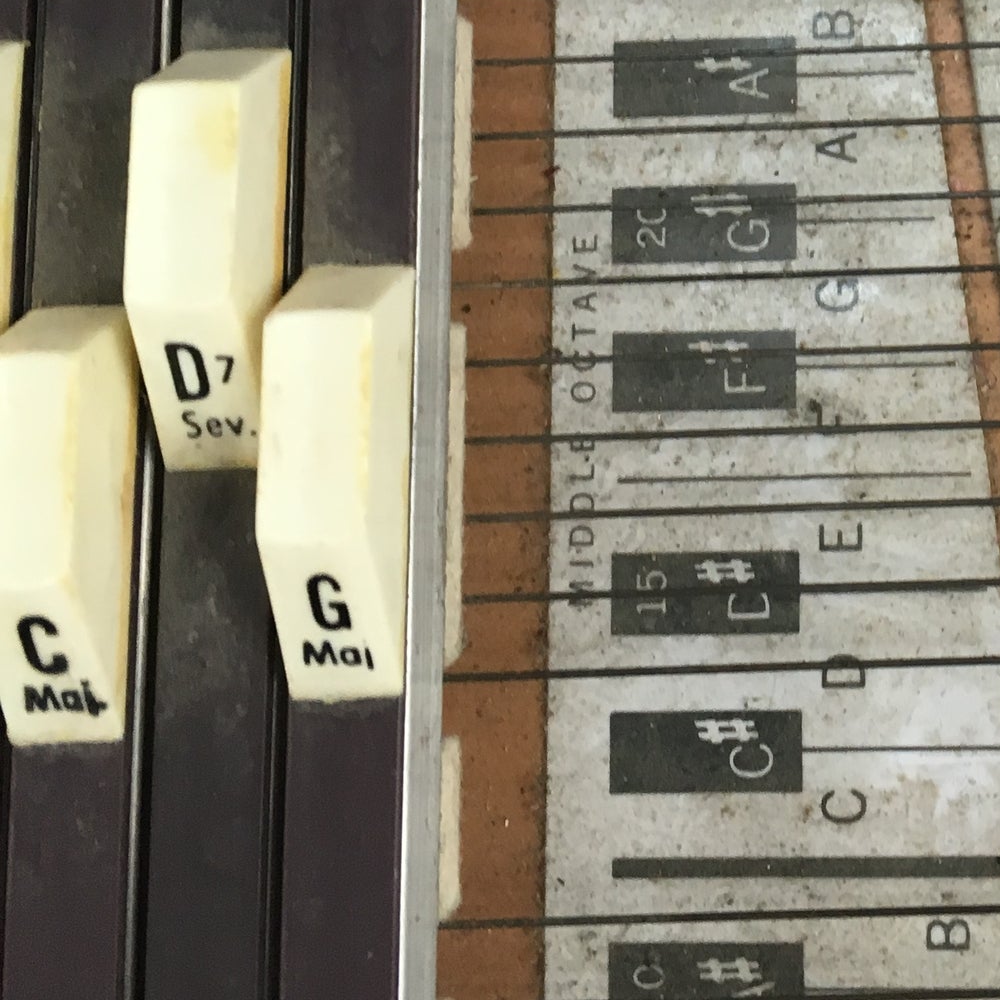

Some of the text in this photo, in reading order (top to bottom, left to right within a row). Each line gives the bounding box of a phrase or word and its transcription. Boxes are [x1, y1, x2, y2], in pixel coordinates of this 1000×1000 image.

[813, 9, 855, 40] B
[816, 132, 857, 163] A
[815, 278, 859, 313] G
[182, 411, 257, 438] Sev.
[819, 522, 862, 552] E
[306, 573, 352, 630] G
[636, 570, 667, 614] 15
[17, 615, 69, 674] C
[822, 653, 865, 688] D
[820, 789, 866, 823] C
[926, 920, 970, 950] B
